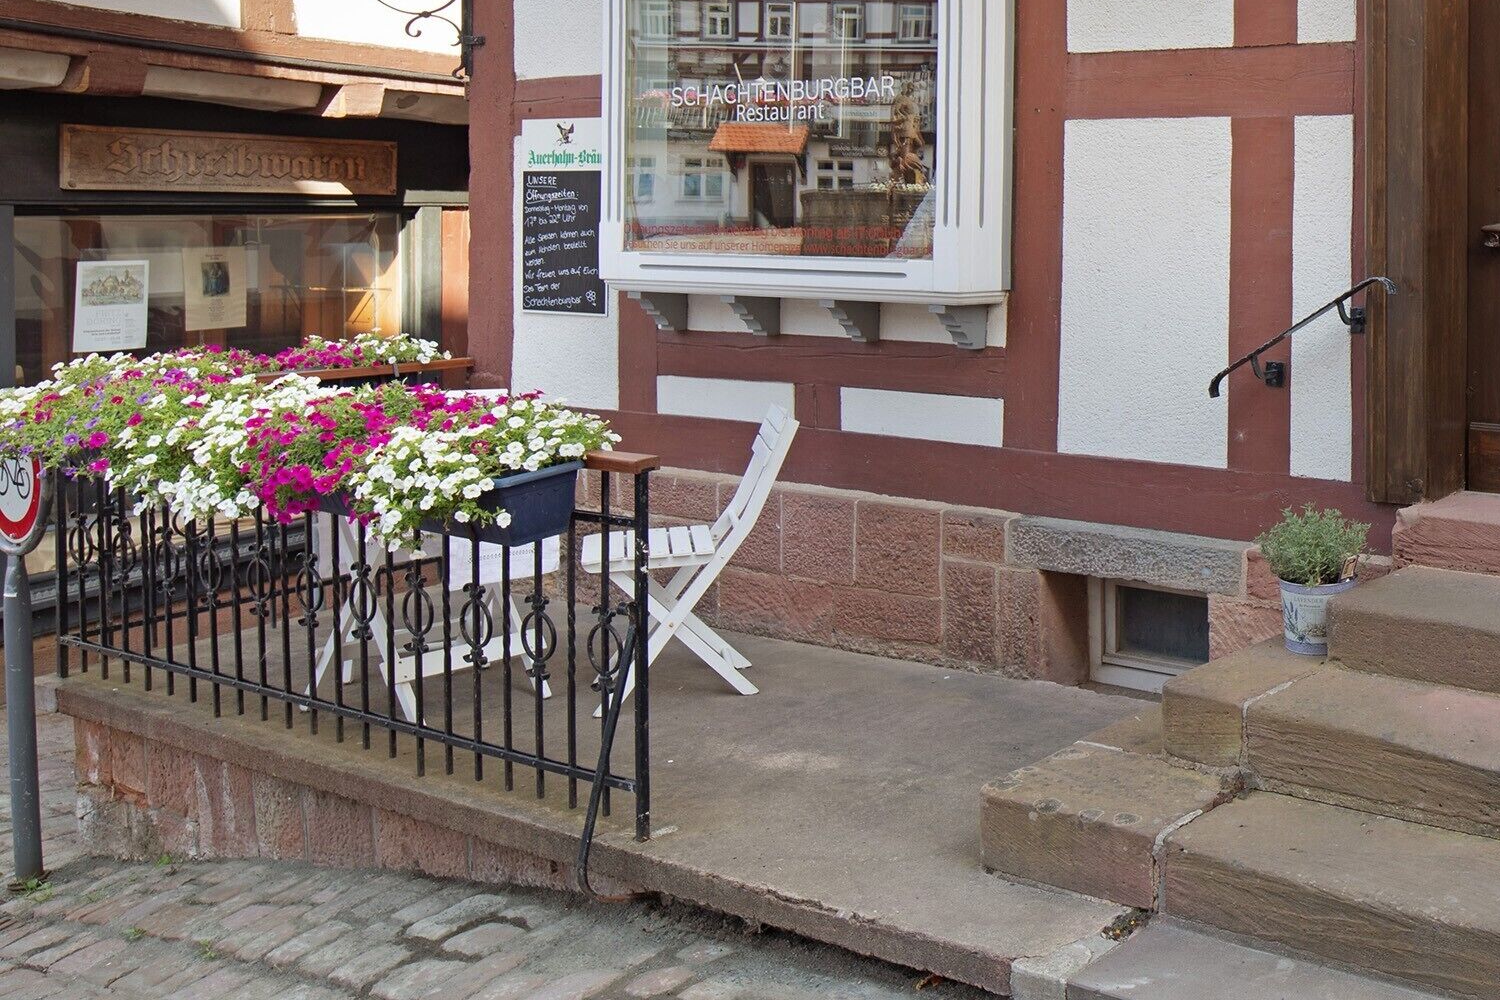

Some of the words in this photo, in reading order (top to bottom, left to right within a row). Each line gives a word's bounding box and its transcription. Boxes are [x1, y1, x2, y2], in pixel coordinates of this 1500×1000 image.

[671, 75, 895, 107] SCHACHTENBURGBAR
[736, 102, 825, 122] Restaurant
[106, 135, 365, 182] Schreibwaren
[528, 149, 602, 168] Auerhahn-Bräu
[527, 175, 557, 187] UNSERE
[578, 204, 589, 213] von
[538, 215, 548, 225] bis
[562, 212, 577, 223] Uhr
[665, 238, 678, 250] Sie
[680, 240, 697, 250] uns
[698, 239, 713, 251] auf
[716, 240, 749, 251] unserer
[570, 265, 581, 276] auf
